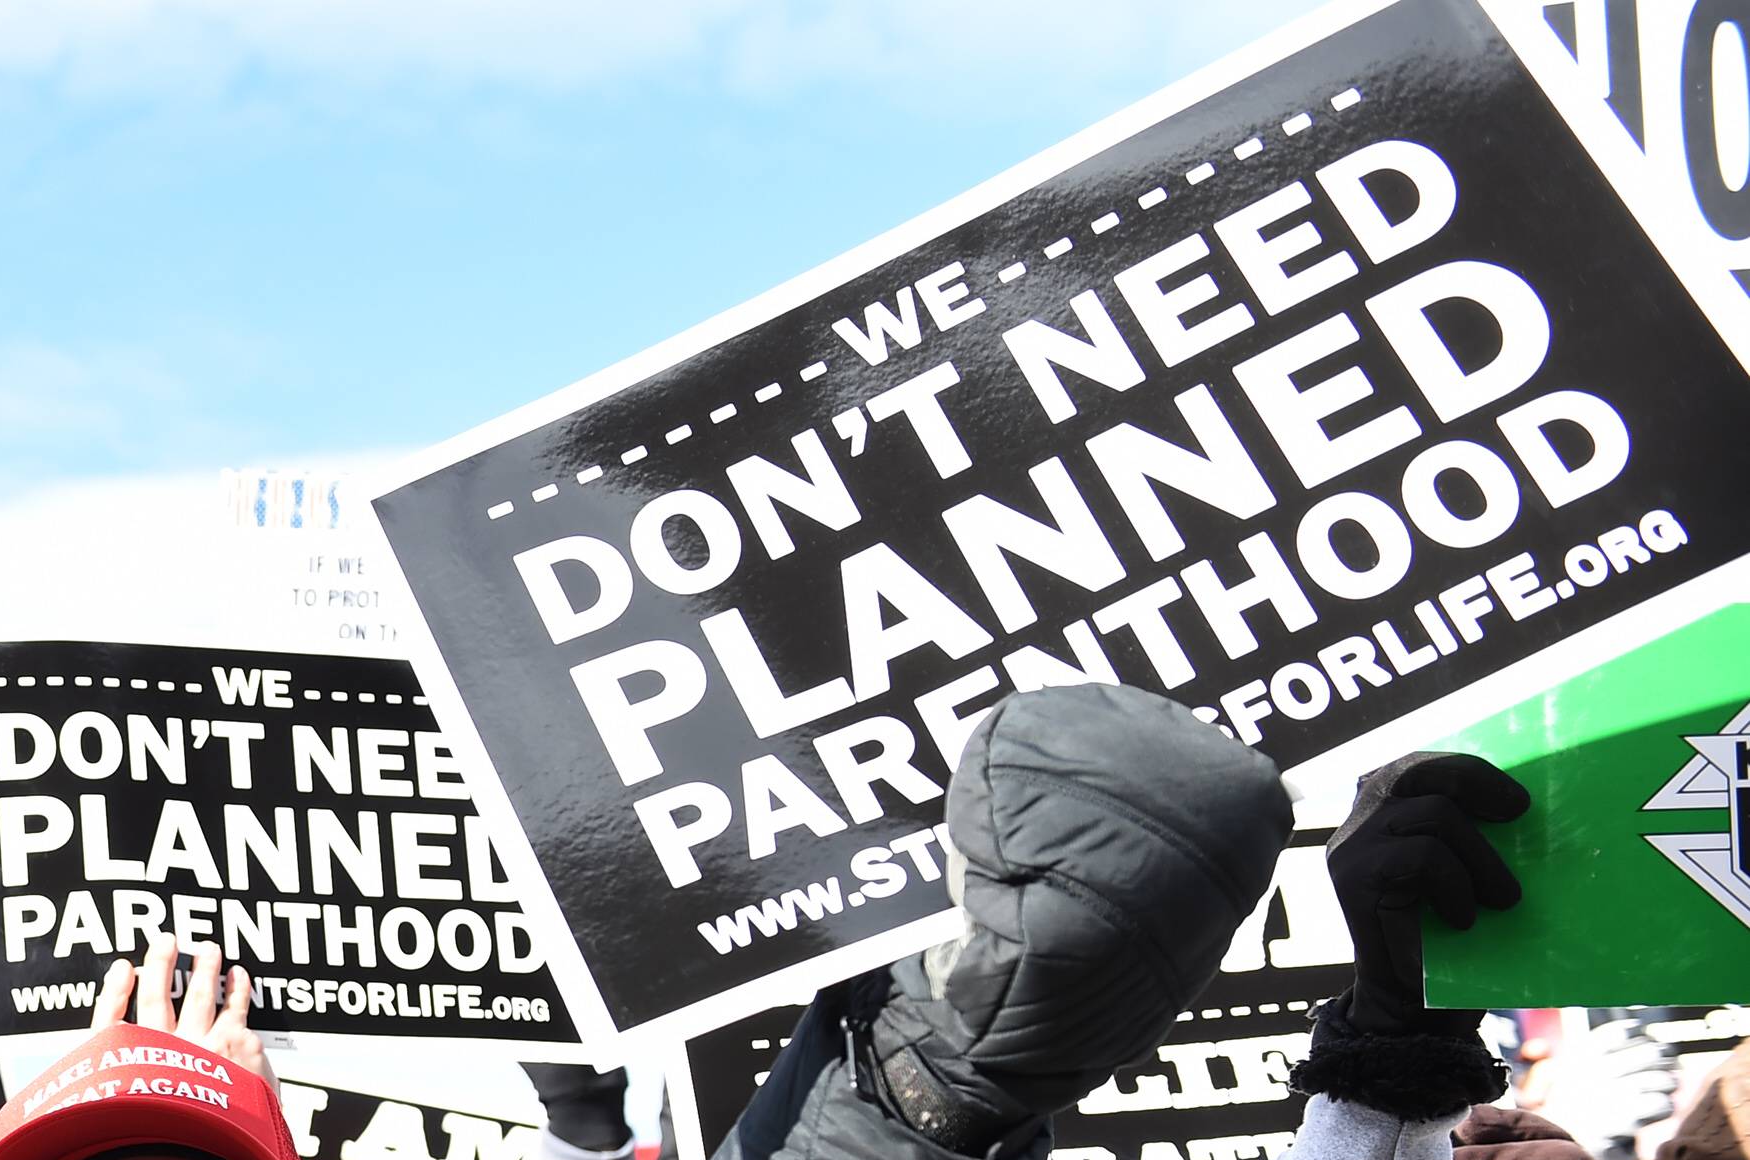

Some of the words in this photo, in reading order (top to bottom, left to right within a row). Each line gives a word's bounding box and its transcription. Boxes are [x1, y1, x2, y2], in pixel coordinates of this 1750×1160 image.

[831, 259, 986, 366] WE
[512, 359, 975, 646] DON'T
[1001, 137, 1458, 424] NEED
[568, 258, 1552, 787] PLANNED
[631, 388, 1632, 890] PARENTHOOD
[210, 665, 294, 709] WE
[290, 724, 474, 801] NEE
[0, 888, 551, 975] PARENTHOOD
[97, 1046, 234, 1086] AMERICA
[127, 1077, 230, 1110] AGAIN
